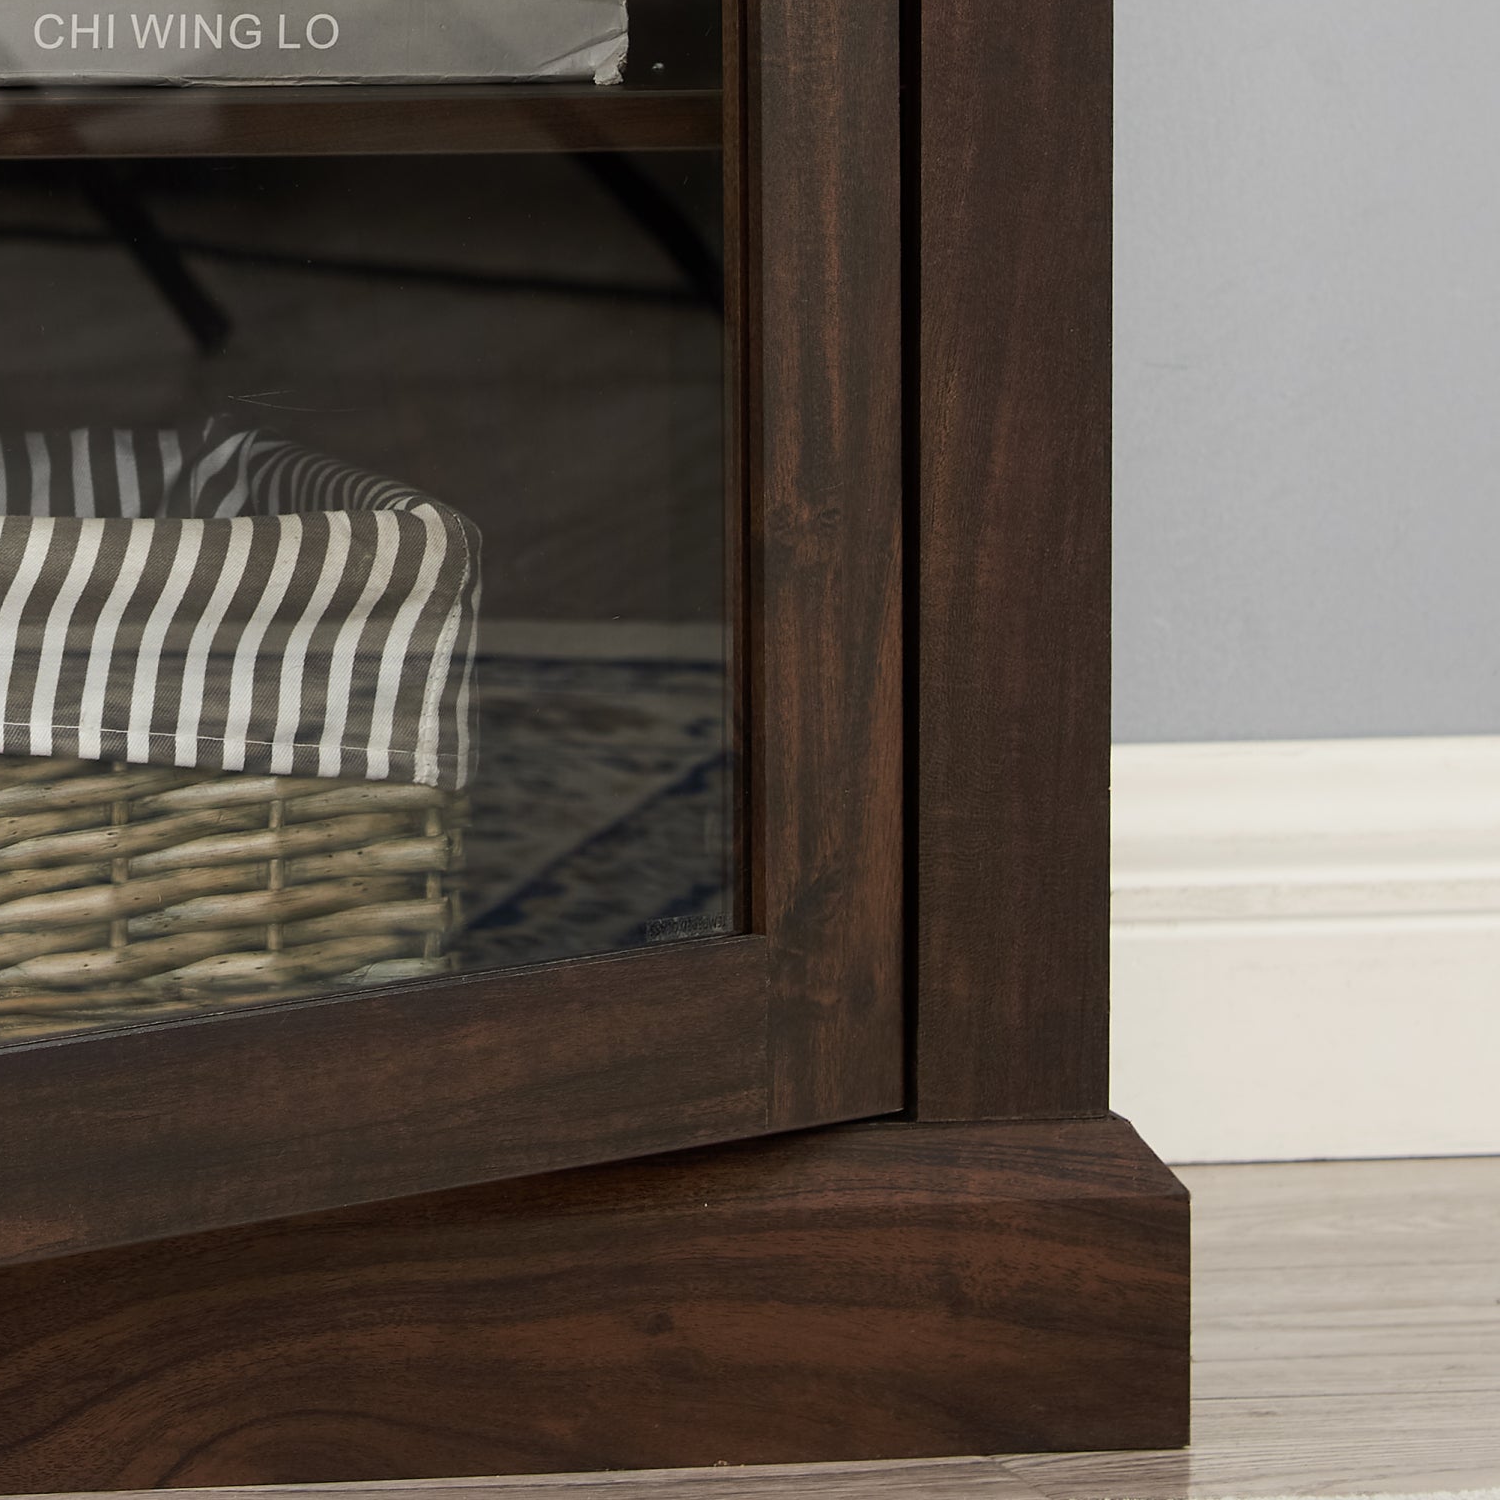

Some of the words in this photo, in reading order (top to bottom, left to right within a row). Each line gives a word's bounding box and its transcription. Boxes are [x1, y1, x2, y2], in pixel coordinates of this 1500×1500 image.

[34, 13, 115, 50] CHI
[130, 13, 262, 50] WING
[278, 13, 339, 50] LO
